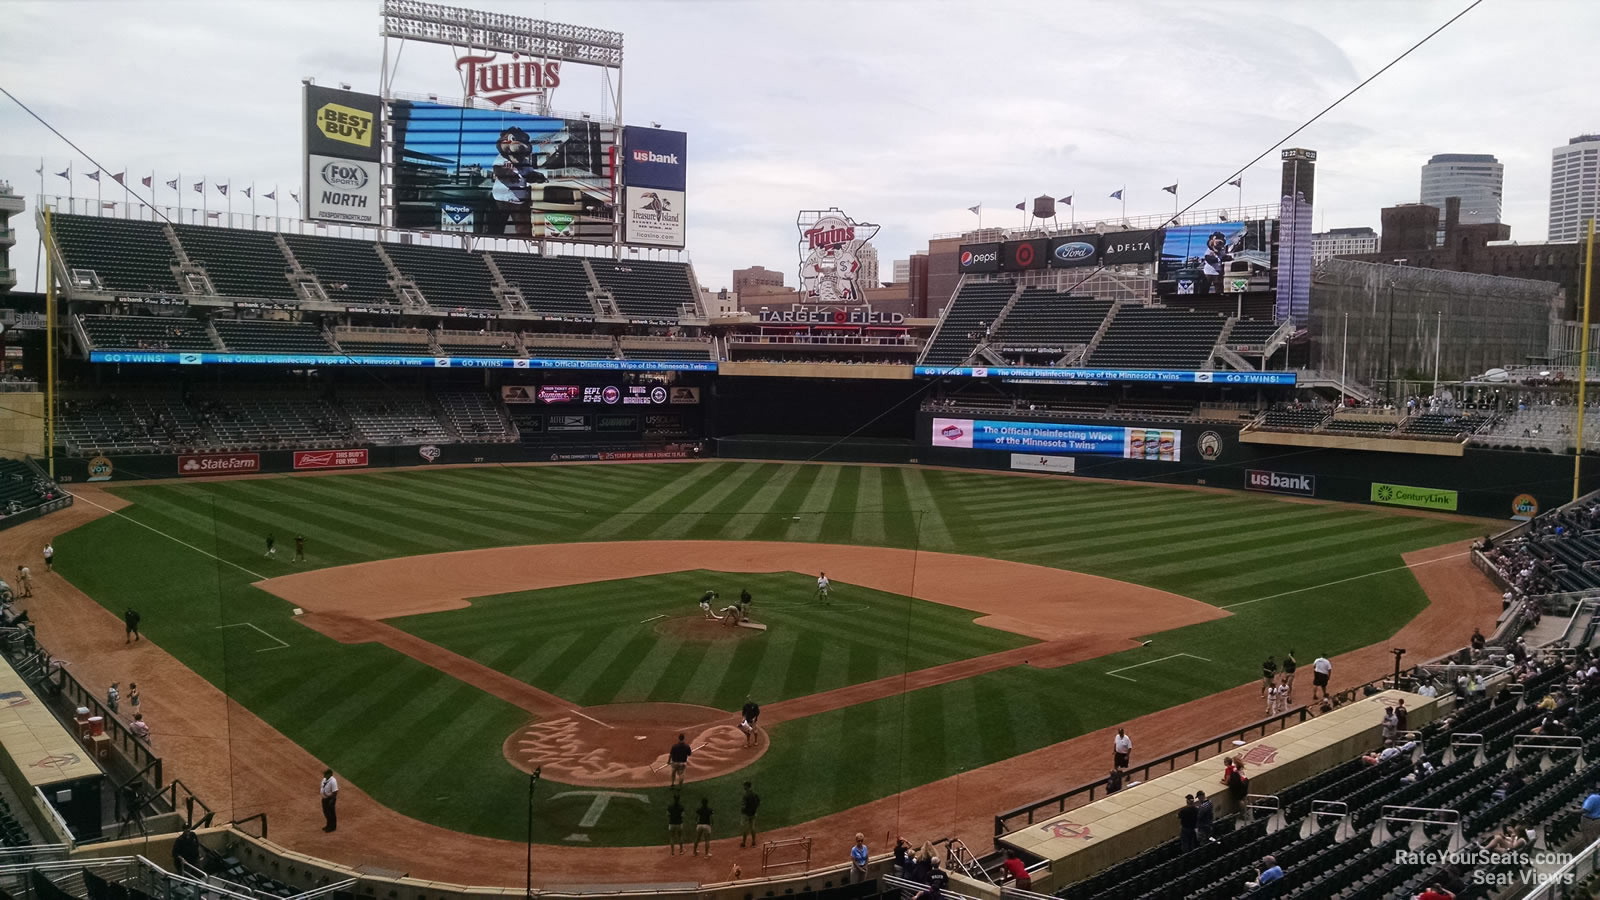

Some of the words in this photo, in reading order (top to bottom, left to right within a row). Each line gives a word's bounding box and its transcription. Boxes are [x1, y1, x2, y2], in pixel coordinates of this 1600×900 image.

[456, 52, 560, 99] Twins
[324, 109, 371, 130] BEST
[325, 121, 366, 140] BUY
[331, 165, 358, 181] FOX
[330, 177, 359, 186] SPORTS
[321, 191, 367, 208] NORTH
[446, 204, 470, 212] Recycle
[547, 215, 573, 223] Organics
[632, 209, 656, 221] Treasure
[661, 212, 680, 223] Island
[636, 232, 675, 240] ticasino.com
[804, 225, 855, 251] Twins
[1062, 244, 1088, 260] Ford
[1117, 242, 1151, 256] DELTA
[973, 251, 997, 265] pepsi
[760, 311, 833, 323] TARGET
[850, 312, 904, 324] FIELD
[104, 354, 121, 362] GO
[125, 354, 166, 363] TWINS!
[218, 355, 233, 363] The
[235, 355, 265, 363] Official
[267, 357, 315, 365] Disinfecting
[318, 357, 337, 365] Wipe
[363, 357, 400, 365] Minnesota
[402, 358, 422, 366] Twins
[581, 361, 619, 370] Disinfecting
[620, 362, 637, 370] Wipe
[1011, 370, 1033, 378] Official
[1035, 371, 1075, 380] Disinfecting
[1077, 372, 1095, 380] Wipe
[1118, 372, 1156, 380] Minnesota
[1244, 375, 1280, 383] TWINS!
[629, 386, 646, 394] TWINS
[984, 427, 999, 435] The
[1001, 427, 1032, 437] Official
[1034, 429, 1086, 443] Disinfecting
[1089, 432, 1113, 444] Wipe
[1006, 437, 1020, 445] the
[1022, 437, 1067, 448] Minnesota
[1069, 440, 1096, 450] Twins
[1395, 490, 1450, 505] CenturyLink
[1515, 504, 1536, 512] VOTE
